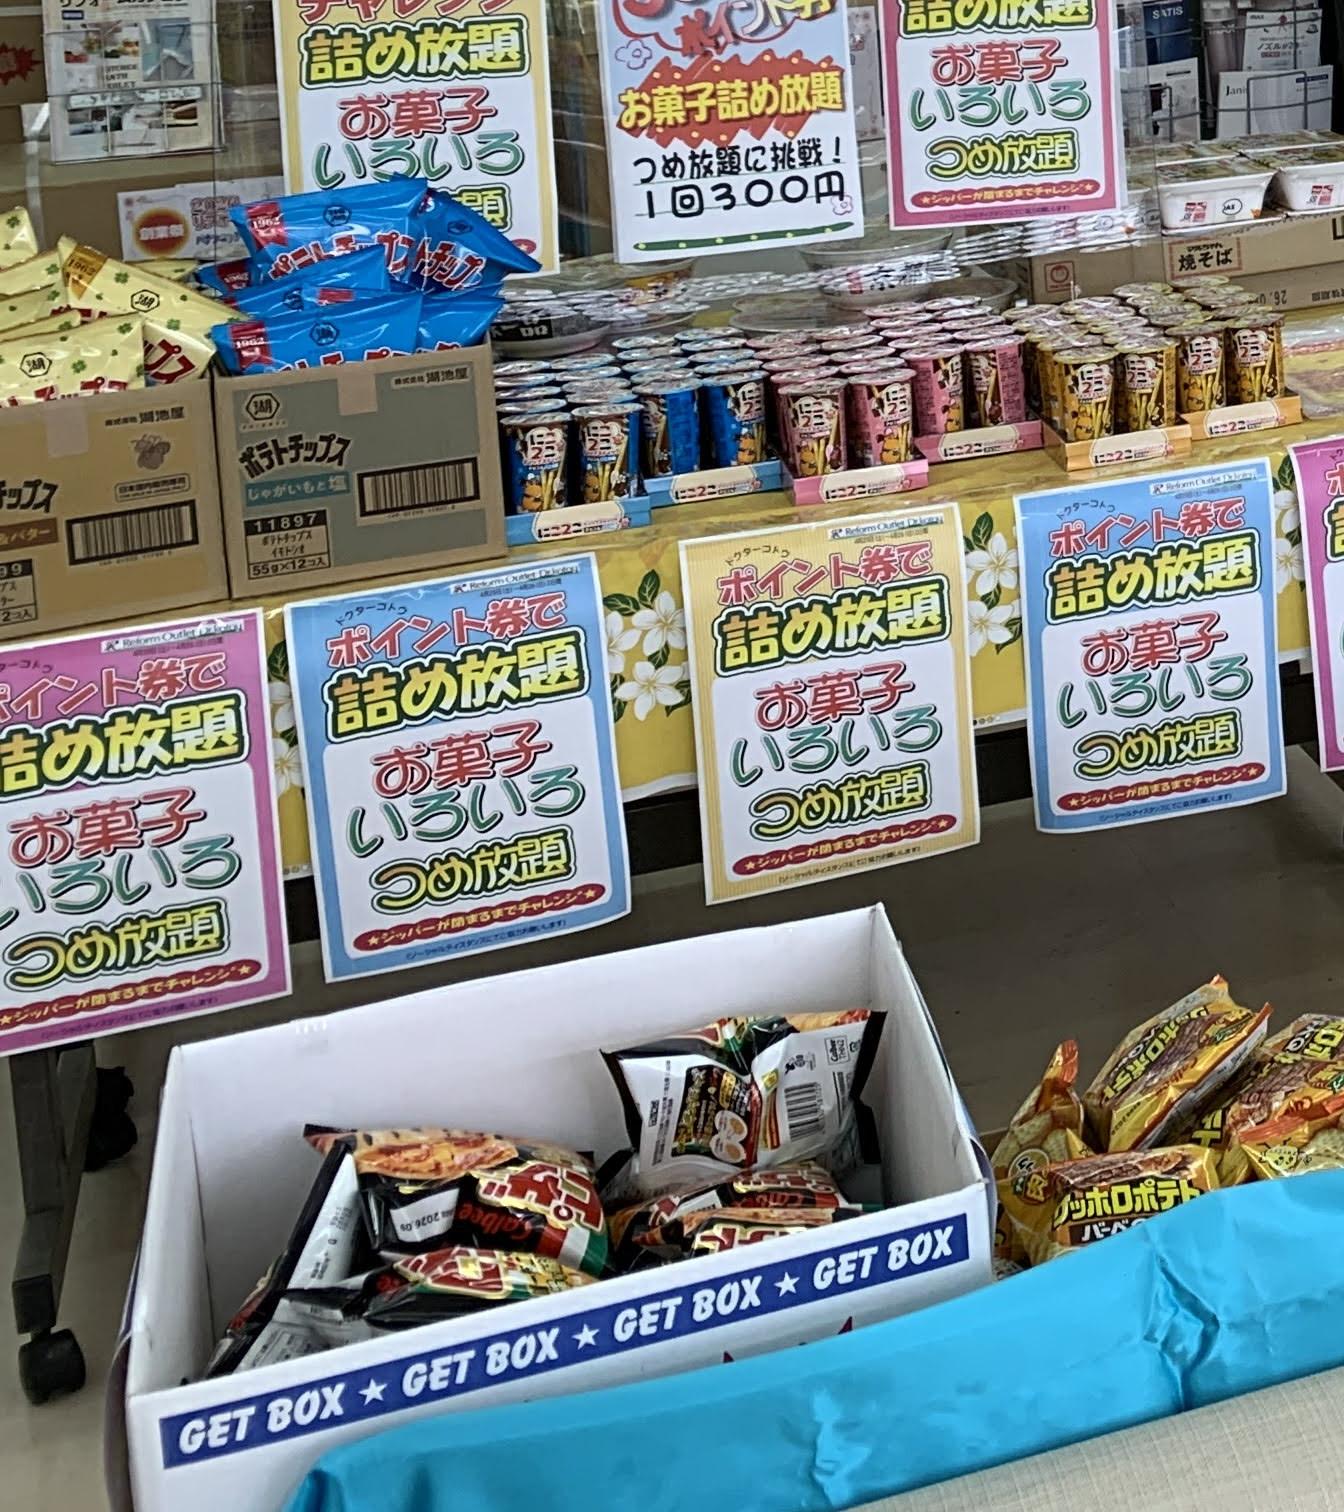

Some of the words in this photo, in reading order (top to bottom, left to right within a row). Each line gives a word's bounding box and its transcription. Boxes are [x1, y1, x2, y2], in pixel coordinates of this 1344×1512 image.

[1152, 6, 1184, 19] SATIS
[932, 38, 1068, 85] お菓子
[338, 85, 497, 140] お菓子
[622, 70, 844, 128] お菓子詰め放題
[1178, 250, 1234, 273] 焼そば
[425, 367, 469, 387] 湖池屋
[238, 432, 351, 480] ポテトチップス
[253, 511, 318, 532] 11897
[1049, 497, 1245, 558] ポイント券で
[718, 541, 933, 606] ポイント券で
[327, 592, 567, 667] ポイント券で
[720, 581, 946, 668] 詰め放題
[330, 632, 583, 735] 詰め放題
[372, 719, 551, 797] お菓子
[346, 766, 585, 858] いろいろ
[374, 828, 572, 909] つめ放題
[691, 1274, 762, 1325] BOX
[811, 1244, 875, 1293] GET
[885, 1224, 955, 1273] BOX
